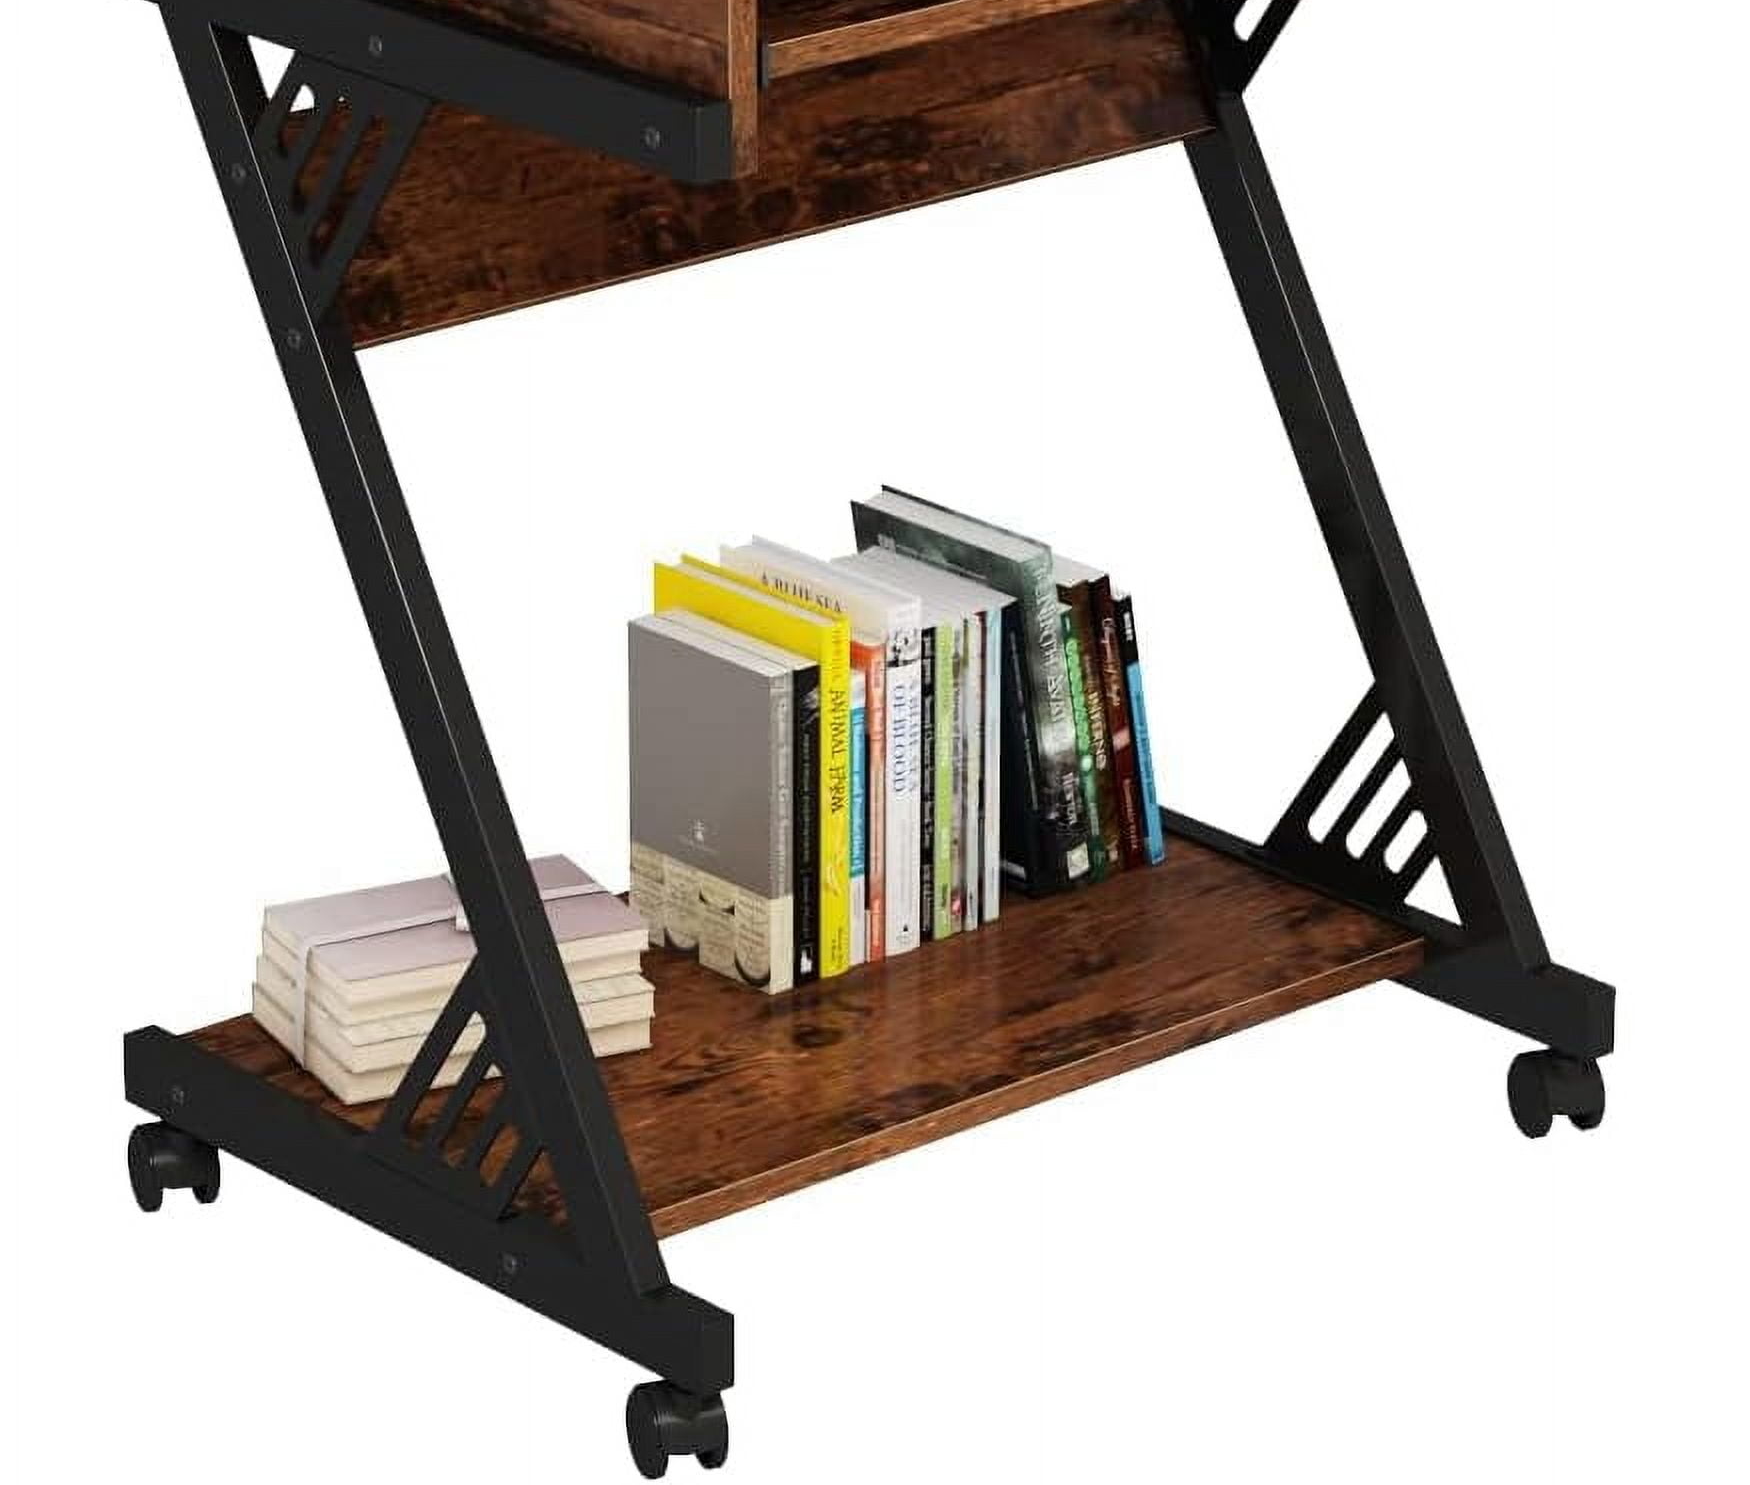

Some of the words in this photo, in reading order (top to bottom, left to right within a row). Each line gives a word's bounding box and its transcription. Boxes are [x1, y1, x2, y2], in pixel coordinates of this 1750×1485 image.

[829, 690, 847, 760] ANIMAL
[893, 716, 906, 793] BLOOD
[829, 765, 847, 814] FARM
